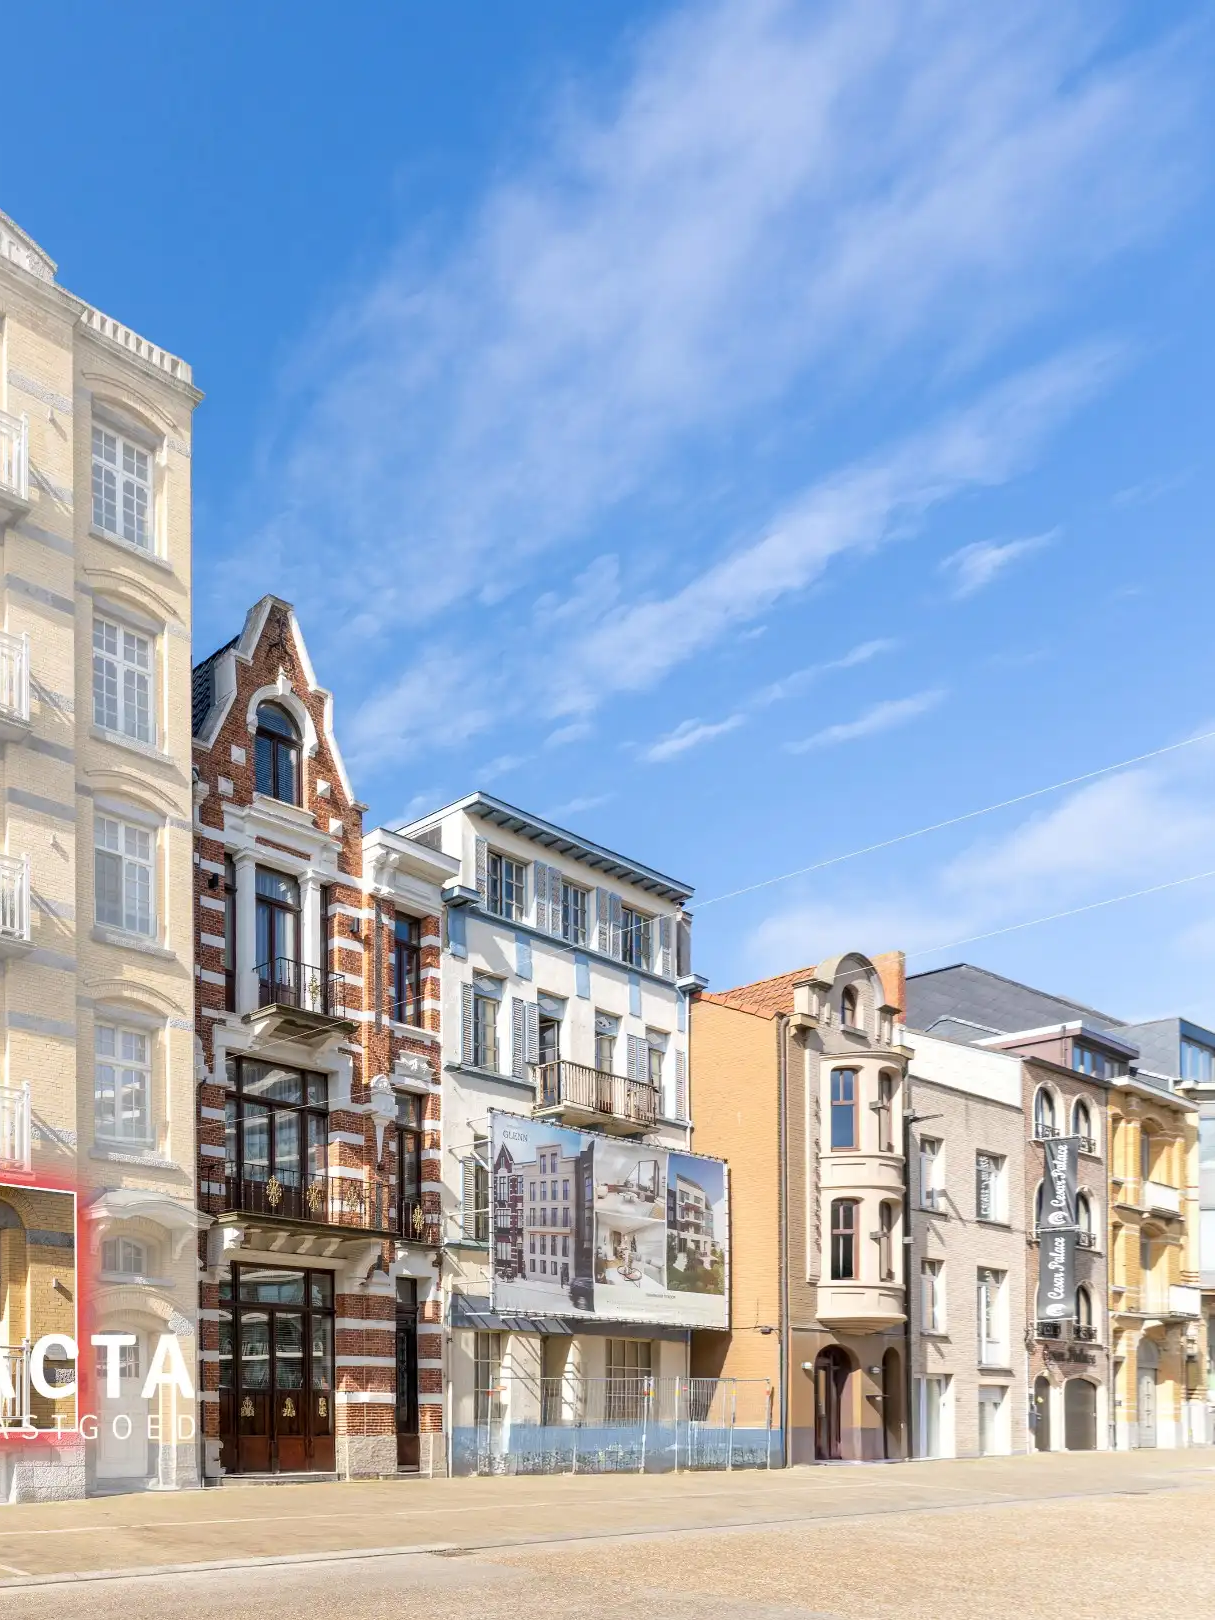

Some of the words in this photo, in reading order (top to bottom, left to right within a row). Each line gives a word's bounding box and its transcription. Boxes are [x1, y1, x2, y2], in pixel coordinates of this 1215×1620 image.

[1050, 1144, 1069, 1179] Palace
[1050, 1179, 1067, 1207] Cesar
[1048, 1236, 1066, 1271] Palace
[1047, 1271, 1065, 1300] Cesar
